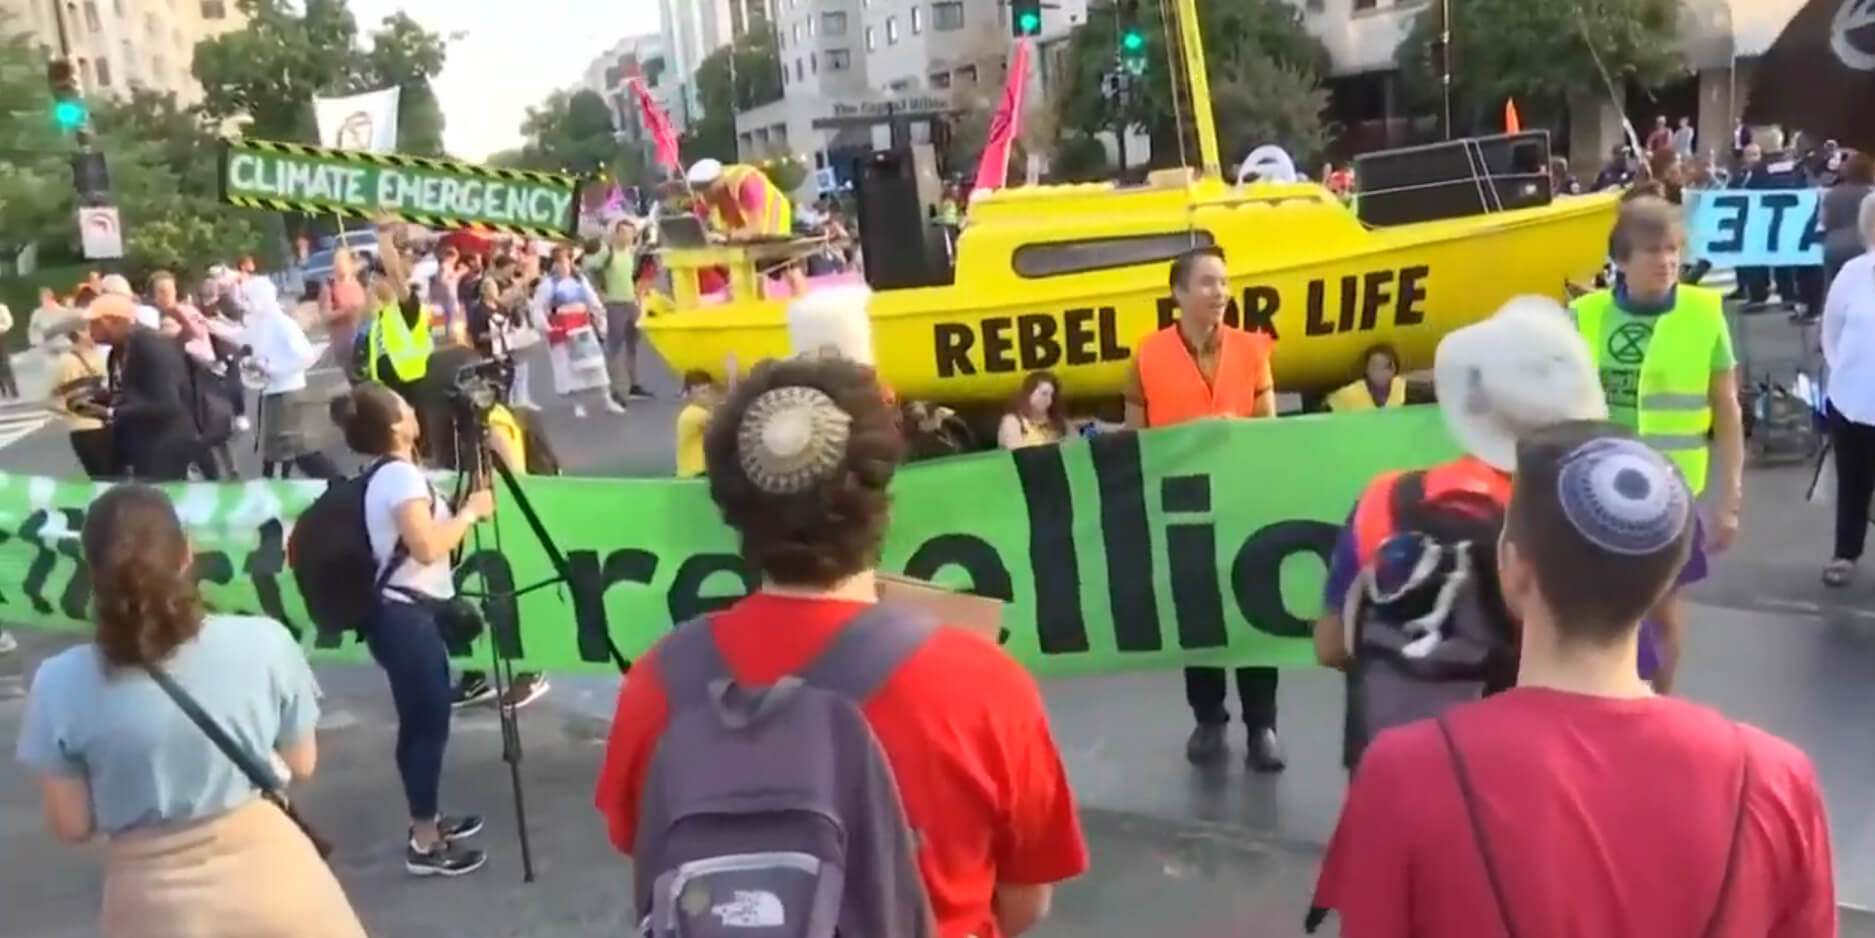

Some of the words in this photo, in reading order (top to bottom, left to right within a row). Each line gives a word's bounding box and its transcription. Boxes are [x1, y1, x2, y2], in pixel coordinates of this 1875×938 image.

[230, 154, 367, 205] CLIMATE
[377, 169, 572, 226] EMERGENCY
[934, 307, 1131, 378] REBEL
[1305, 264, 1429, 336] LIFE
